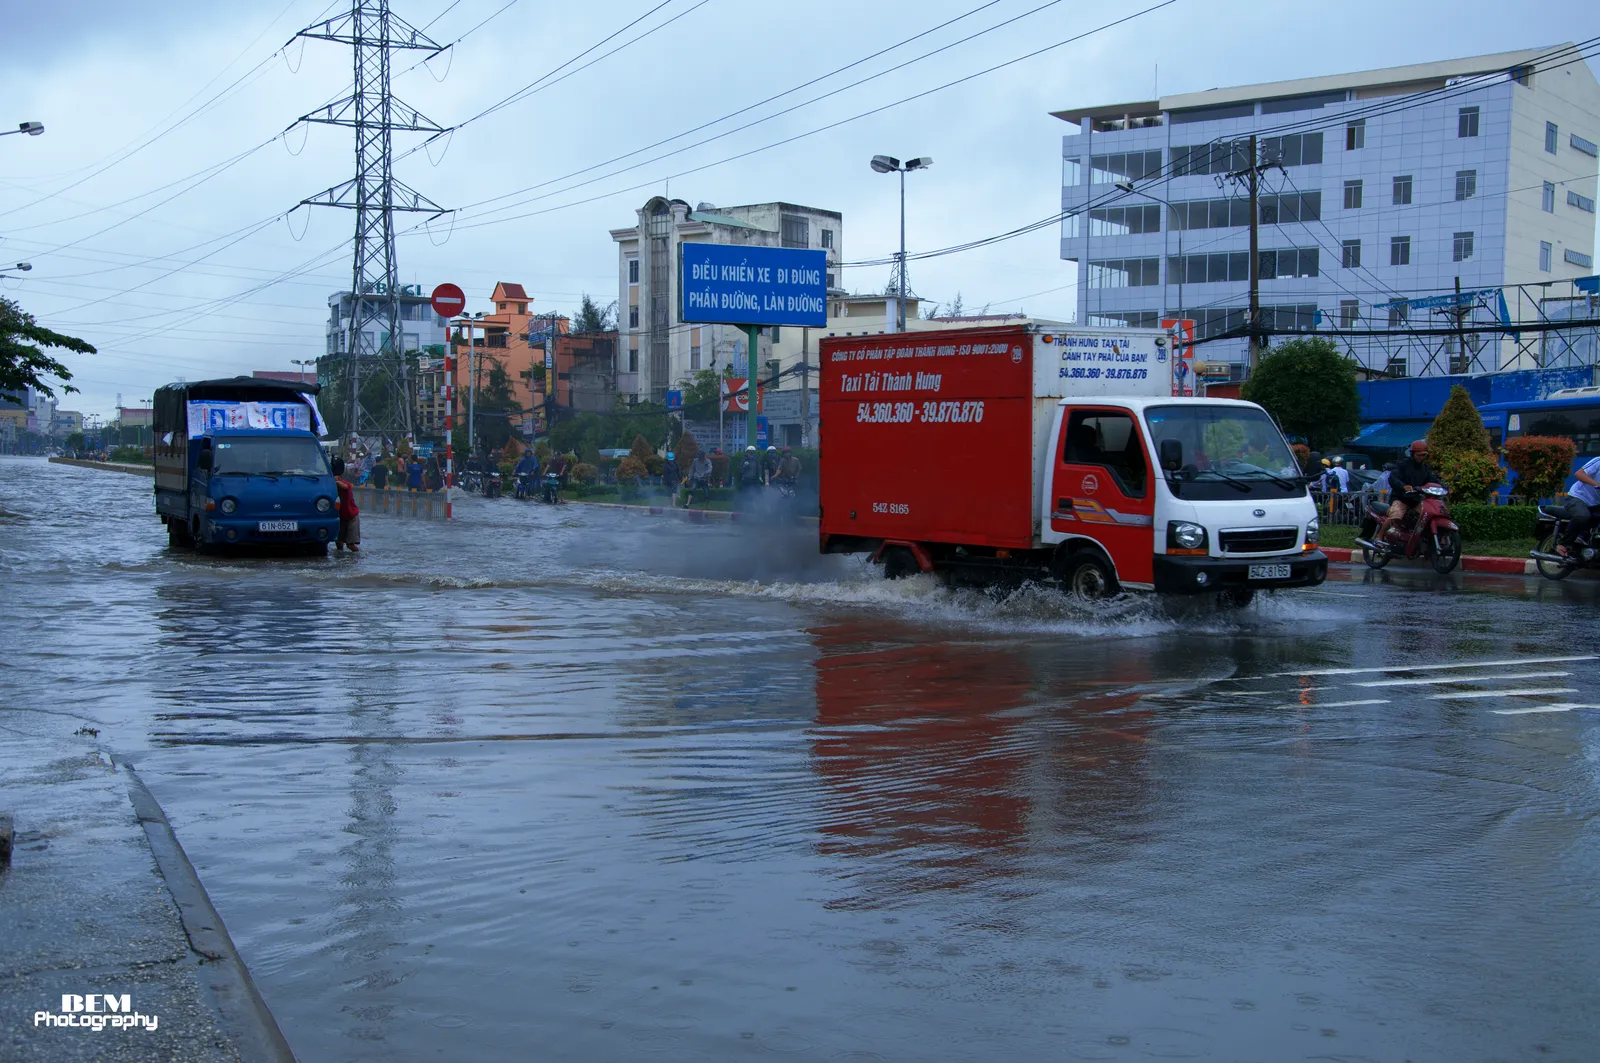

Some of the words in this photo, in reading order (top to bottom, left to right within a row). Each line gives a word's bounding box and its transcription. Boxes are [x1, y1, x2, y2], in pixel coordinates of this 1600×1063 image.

[692, 257, 718, 281] ĐIỀU
[721, 258, 754, 282] KHIỂN
[757, 267, 770, 283] XE
[777, 268, 788, 284] ĐI
[791, 265, 820, 285] ĐÚNG
[689, 286, 718, 308] PHẦN
[721, 290, 761, 313] ĐƯỜNG,
[764, 291, 784, 311] LÀN
[787, 293, 823, 312] ĐƯỜNG
[1101, 338, 1118, 348] TAXI
[848, 351, 856, 361] TY
[1083, 352, 1097, 361] TAY
[841, 372, 862, 392] Taxi
[864, 370, 880, 392] Tải
[882, 370, 912, 392] Thành
[915, 371, 942, 393] Hưng
[872, 502, 888, 513] 54Z
[889, 503, 910, 515] 8165
[1250, 565, 1289, 578] 54Z-8165
